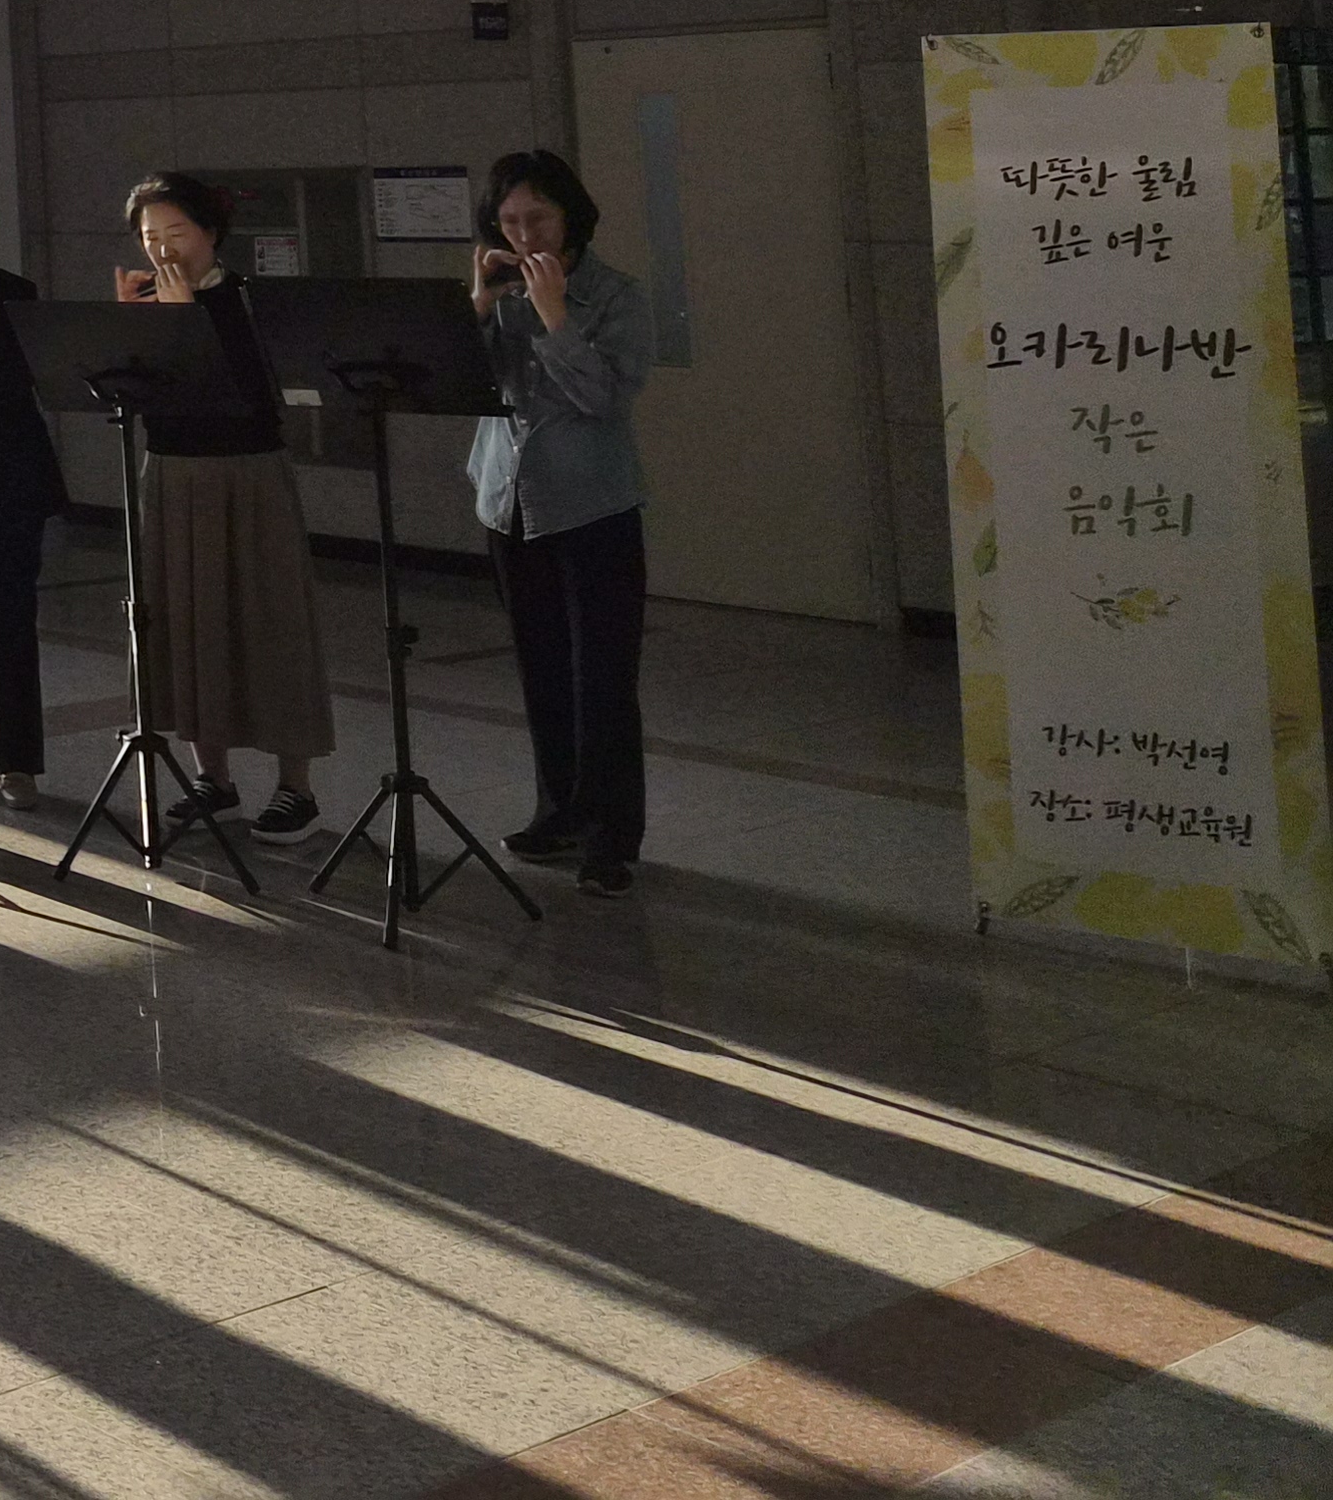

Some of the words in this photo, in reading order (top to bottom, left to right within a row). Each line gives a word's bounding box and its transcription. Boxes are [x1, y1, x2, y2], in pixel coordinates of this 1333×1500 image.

[1000, 156, 1118, 200] 따뜻한
[1132, 155, 1197, 202] 울림
[1032, 219, 1093, 264] 깊은
[1107, 222, 1173, 262] 여운
[987, 322, 1252, 379] 오카리나반
[1070, 404, 1159, 453] 작은
[1063, 483, 1194, 537] 음악회
[1042, 724, 1121, 758] 강사:
[1131, 732, 1230, 775] 박선영
[1030, 790, 1093, 822] 장소:
[1103, 799, 1253, 847] 평생교육원
